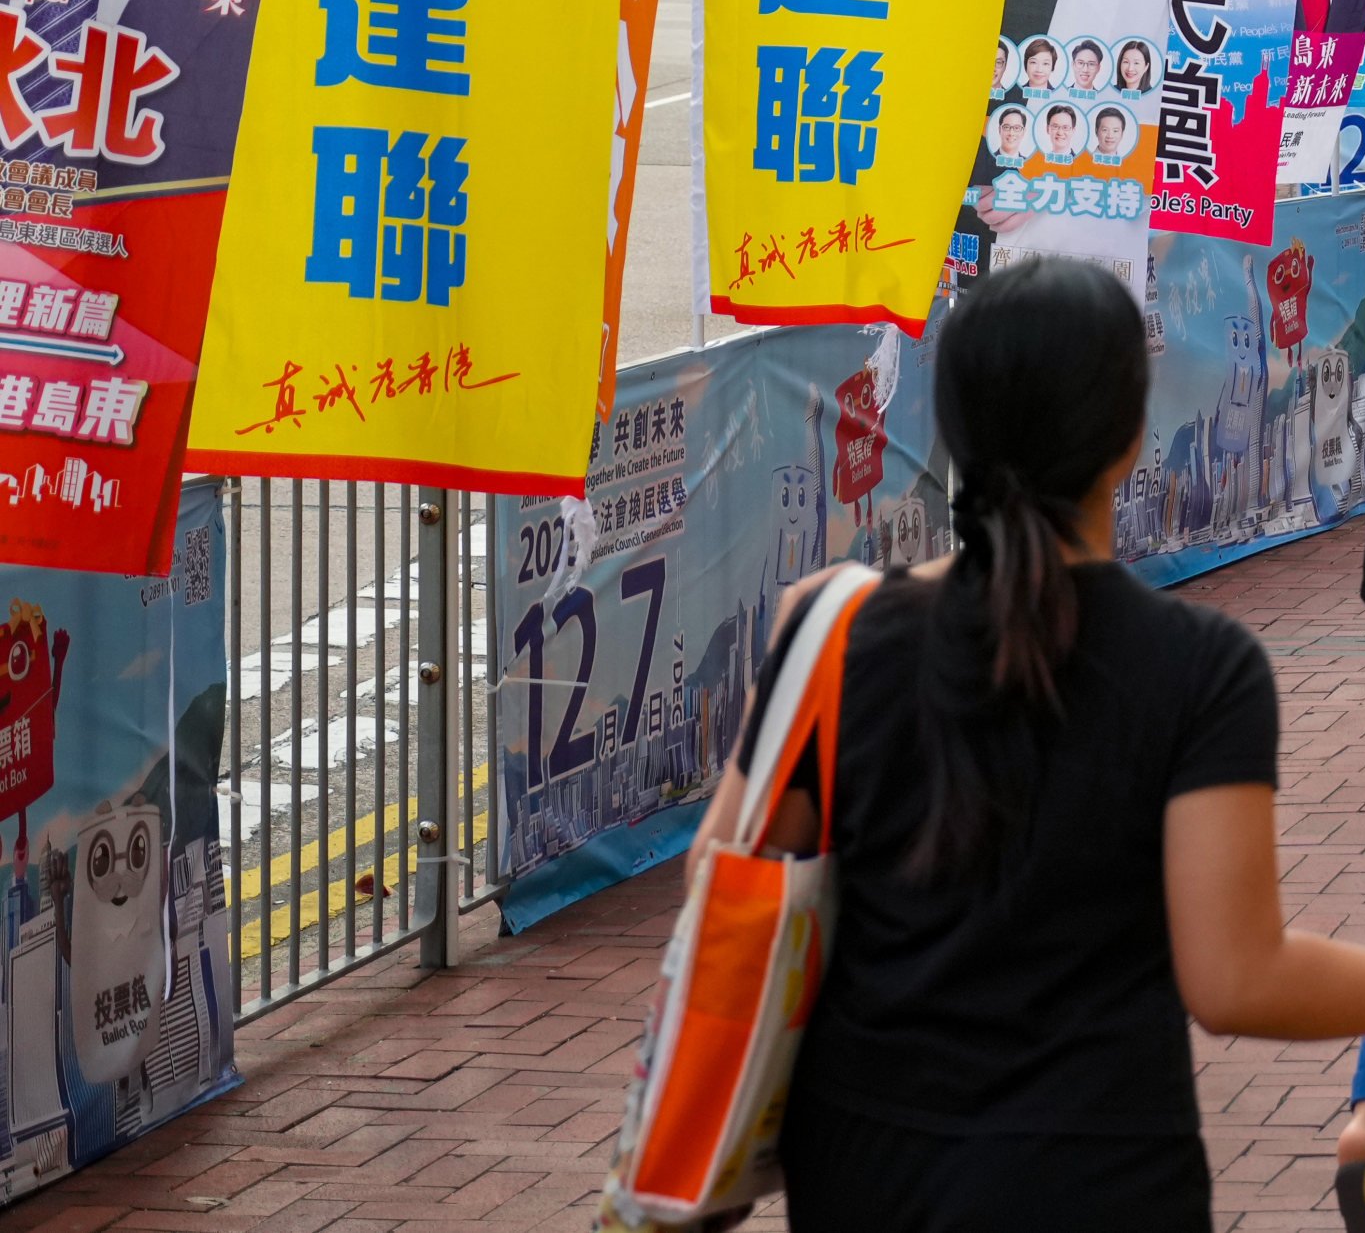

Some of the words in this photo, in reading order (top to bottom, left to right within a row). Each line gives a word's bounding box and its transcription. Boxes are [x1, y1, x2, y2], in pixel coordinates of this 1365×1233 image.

[994, 173, 1141, 218] 全力支持
[1199, 196, 1254, 228] Party
[614, 396, 686, 456] 共創未來
[615, 462, 626, 479] We
[627, 456, 649, 475] Create
[650, 453, 662, 468] the
[662, 446, 685, 464] Future
[592, 476, 687, 535] 法會換屆選舉
[615, 532, 641, 552] Council
[94, 973, 152, 1032] 投票箱
[101, 1024, 129, 1048] Ballot
